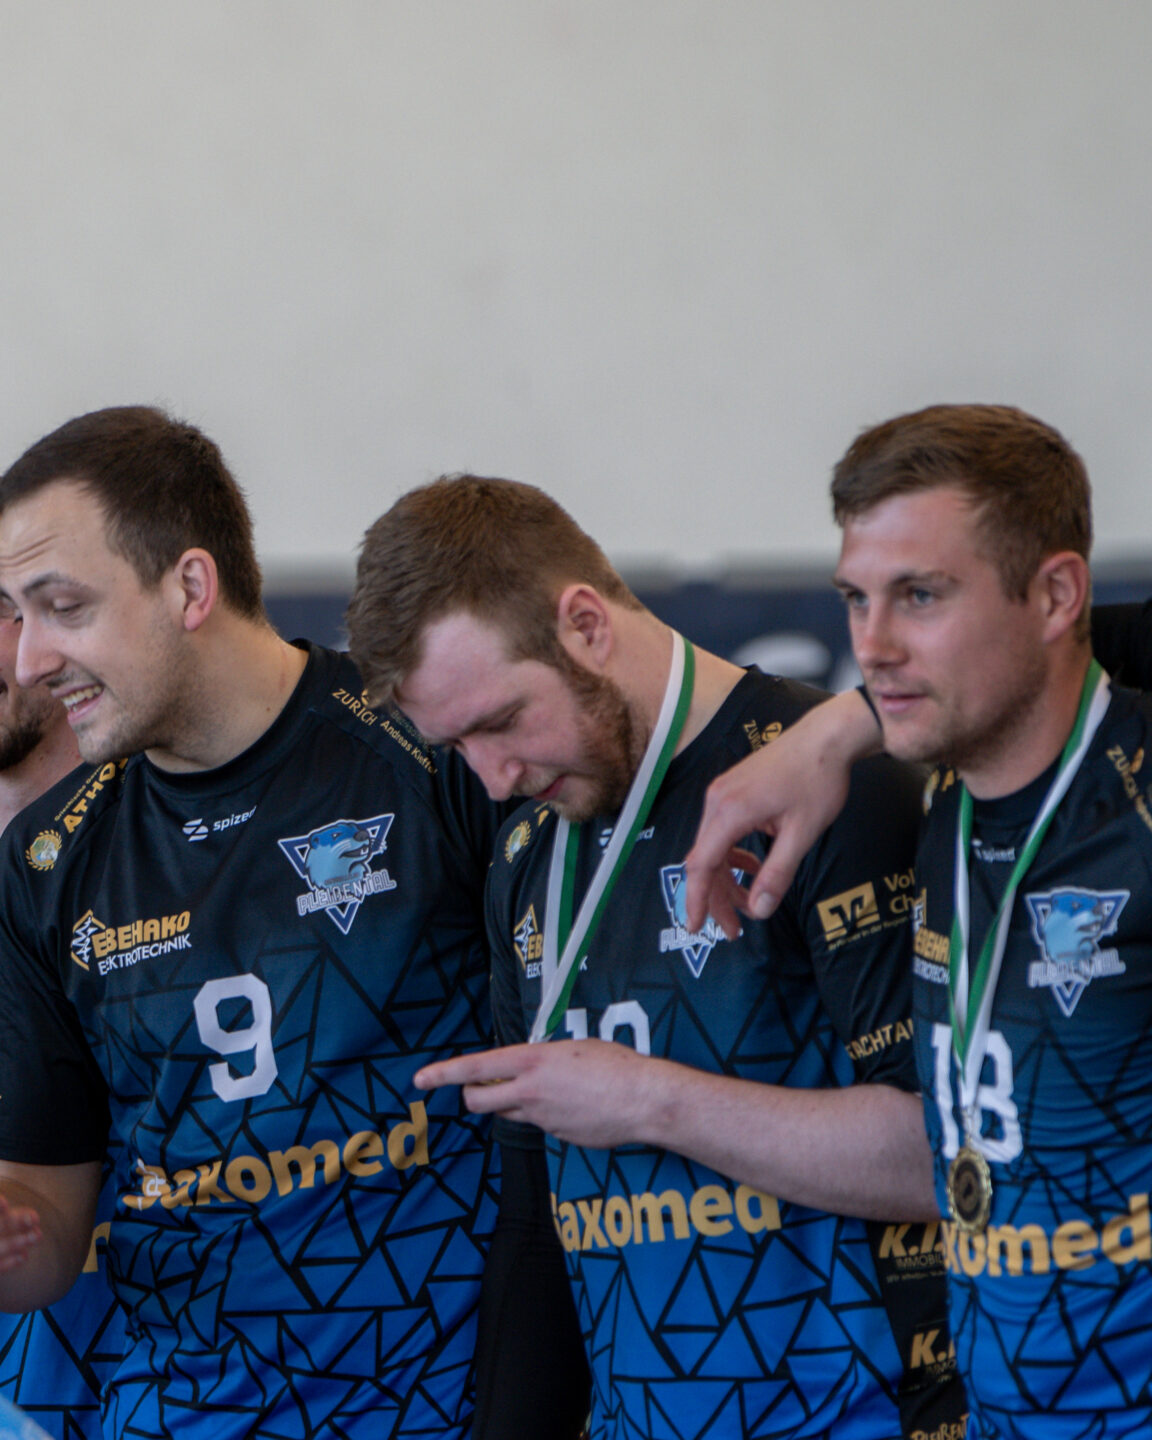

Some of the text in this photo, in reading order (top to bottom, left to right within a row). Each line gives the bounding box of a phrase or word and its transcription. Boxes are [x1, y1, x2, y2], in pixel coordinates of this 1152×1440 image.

[332, 688, 378, 726] ZURICH
[380, 720, 413, 752] Andreas
[92, 910, 191, 958] EBEHAKO
[193, 972, 279, 1103] 9
